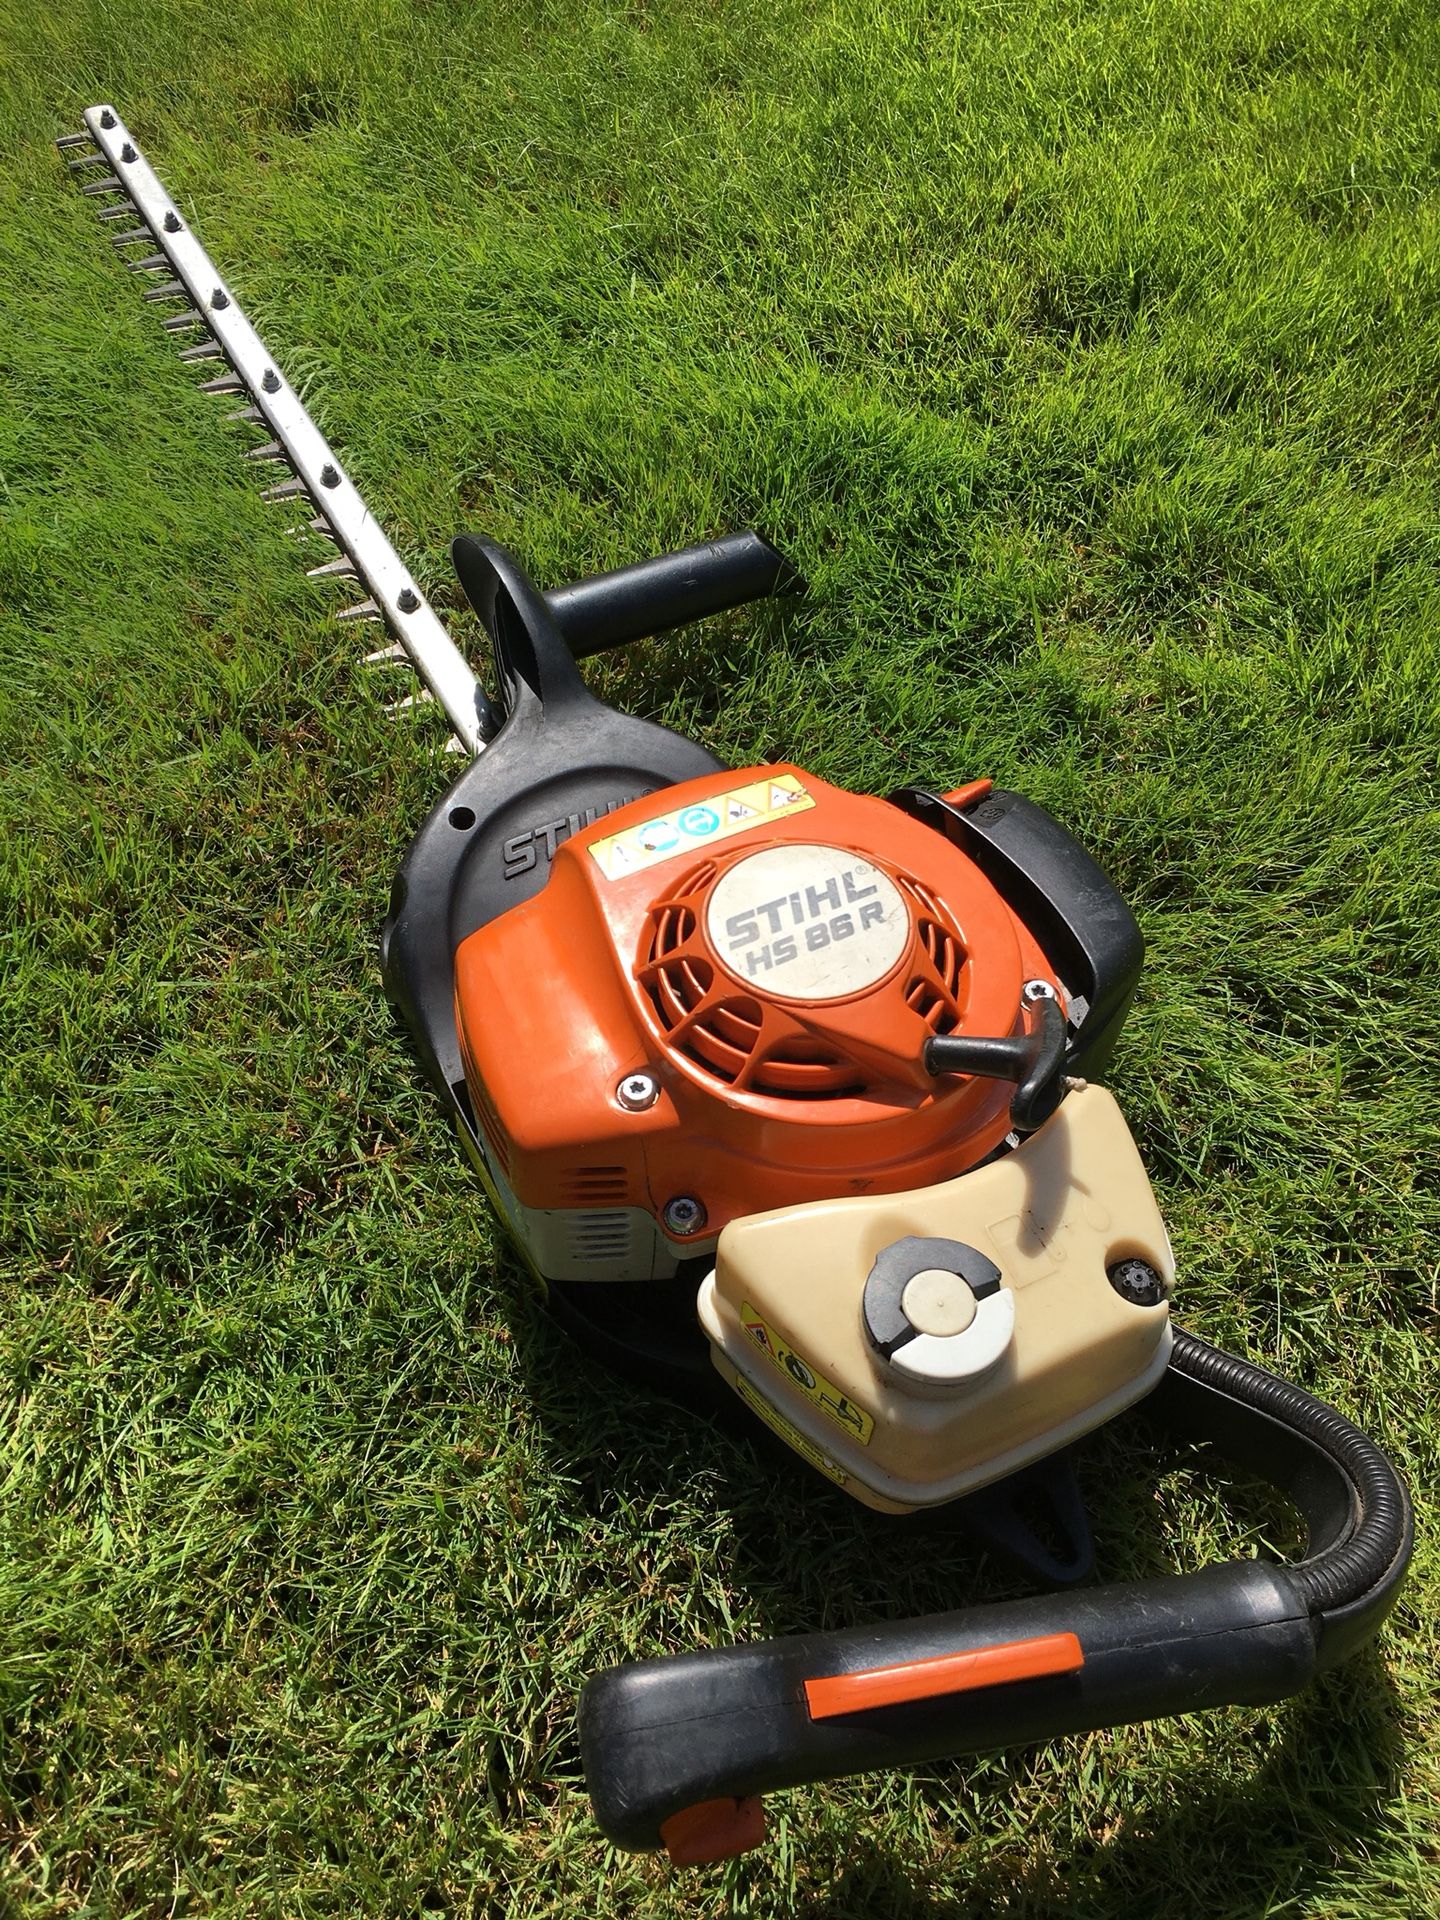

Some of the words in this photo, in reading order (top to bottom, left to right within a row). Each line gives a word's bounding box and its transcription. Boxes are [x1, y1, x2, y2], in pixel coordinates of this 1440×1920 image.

[503, 797, 635, 881] STI
[725, 871, 878, 951] STIHL
[745, 934, 798, 977] HS
[804, 913, 855, 952] 86
[858, 900, 887, 931] R
